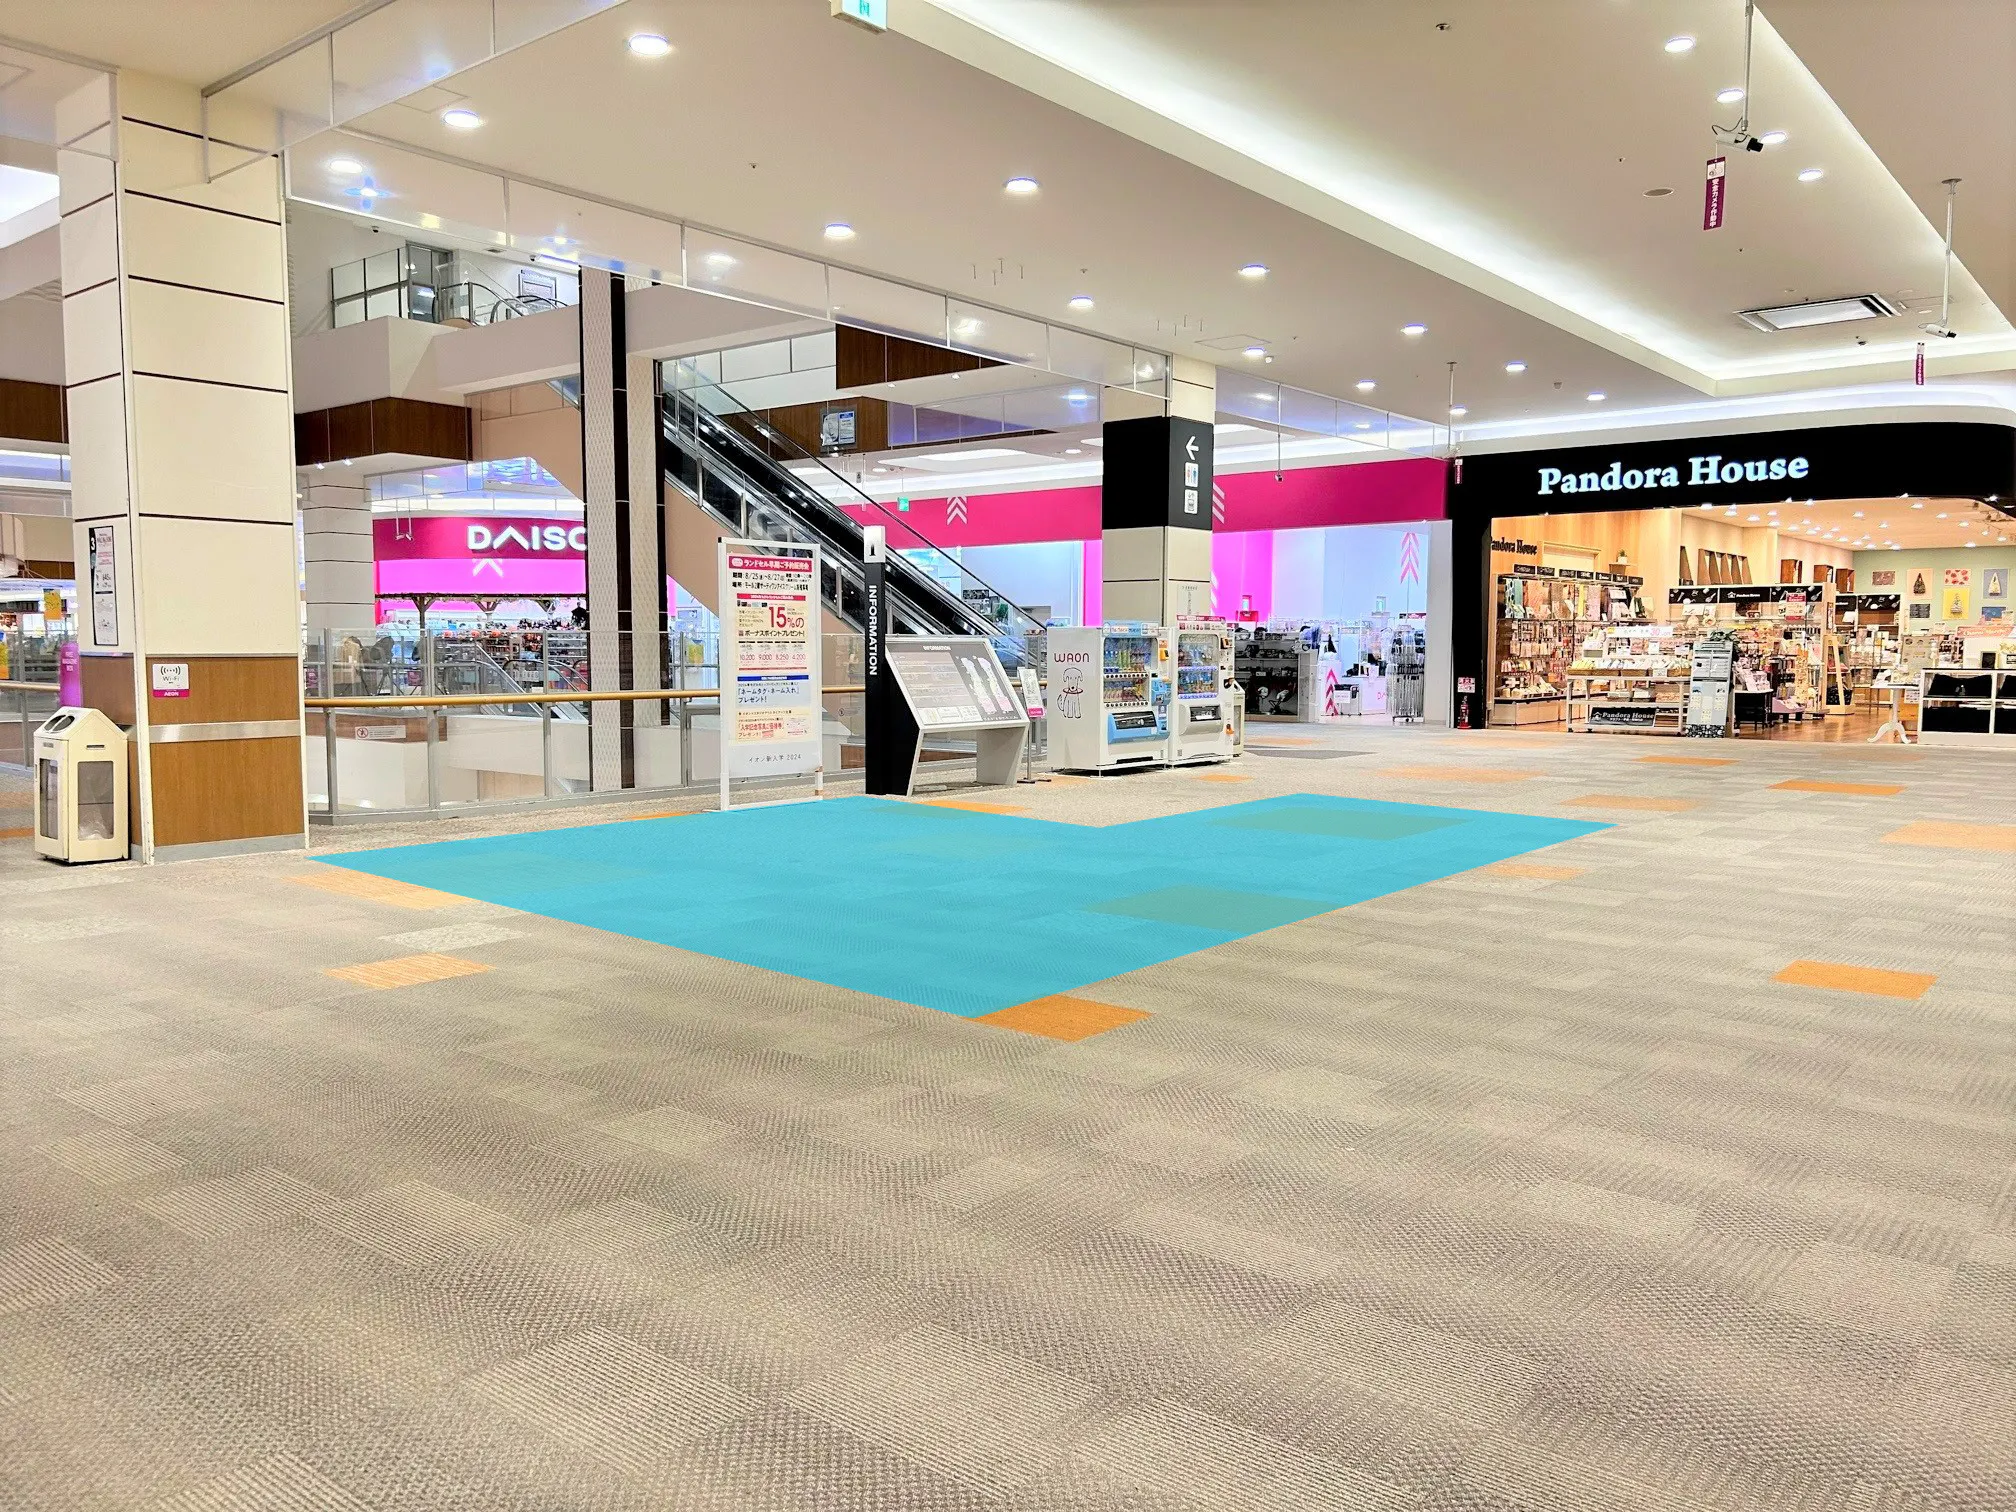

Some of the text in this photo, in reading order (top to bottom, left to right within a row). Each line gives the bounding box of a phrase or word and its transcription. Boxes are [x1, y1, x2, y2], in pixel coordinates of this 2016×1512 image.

[1537, 455, 1810, 495] Pandora House
[1490, 537, 1516, 553] andora
[868, 585, 878, 676] INFORMATION
[1053, 652, 1090, 663] WAON
